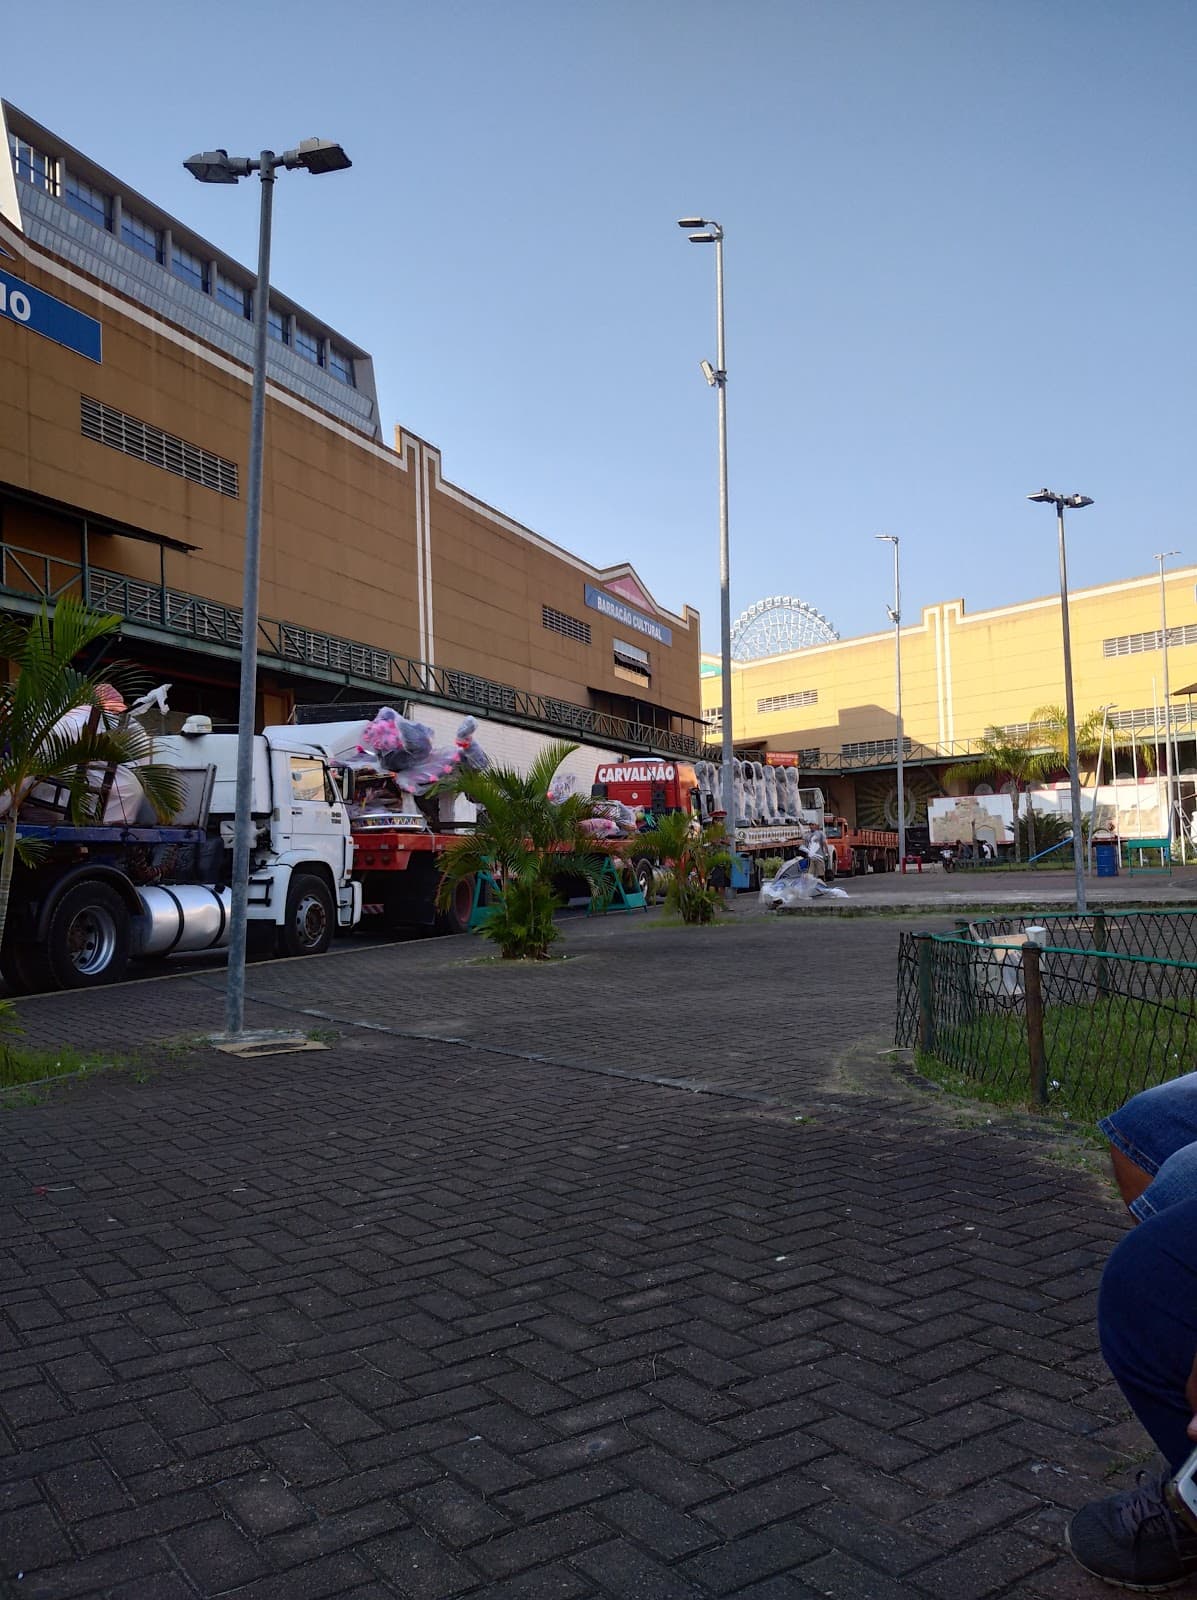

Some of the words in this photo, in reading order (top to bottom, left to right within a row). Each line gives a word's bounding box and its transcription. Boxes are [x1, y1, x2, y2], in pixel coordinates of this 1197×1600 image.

[597, 596, 632, 625] BARRACÃO
[632, 615, 662, 641] CULTURAL
[598, 764, 675, 782] CARVALHÃO
